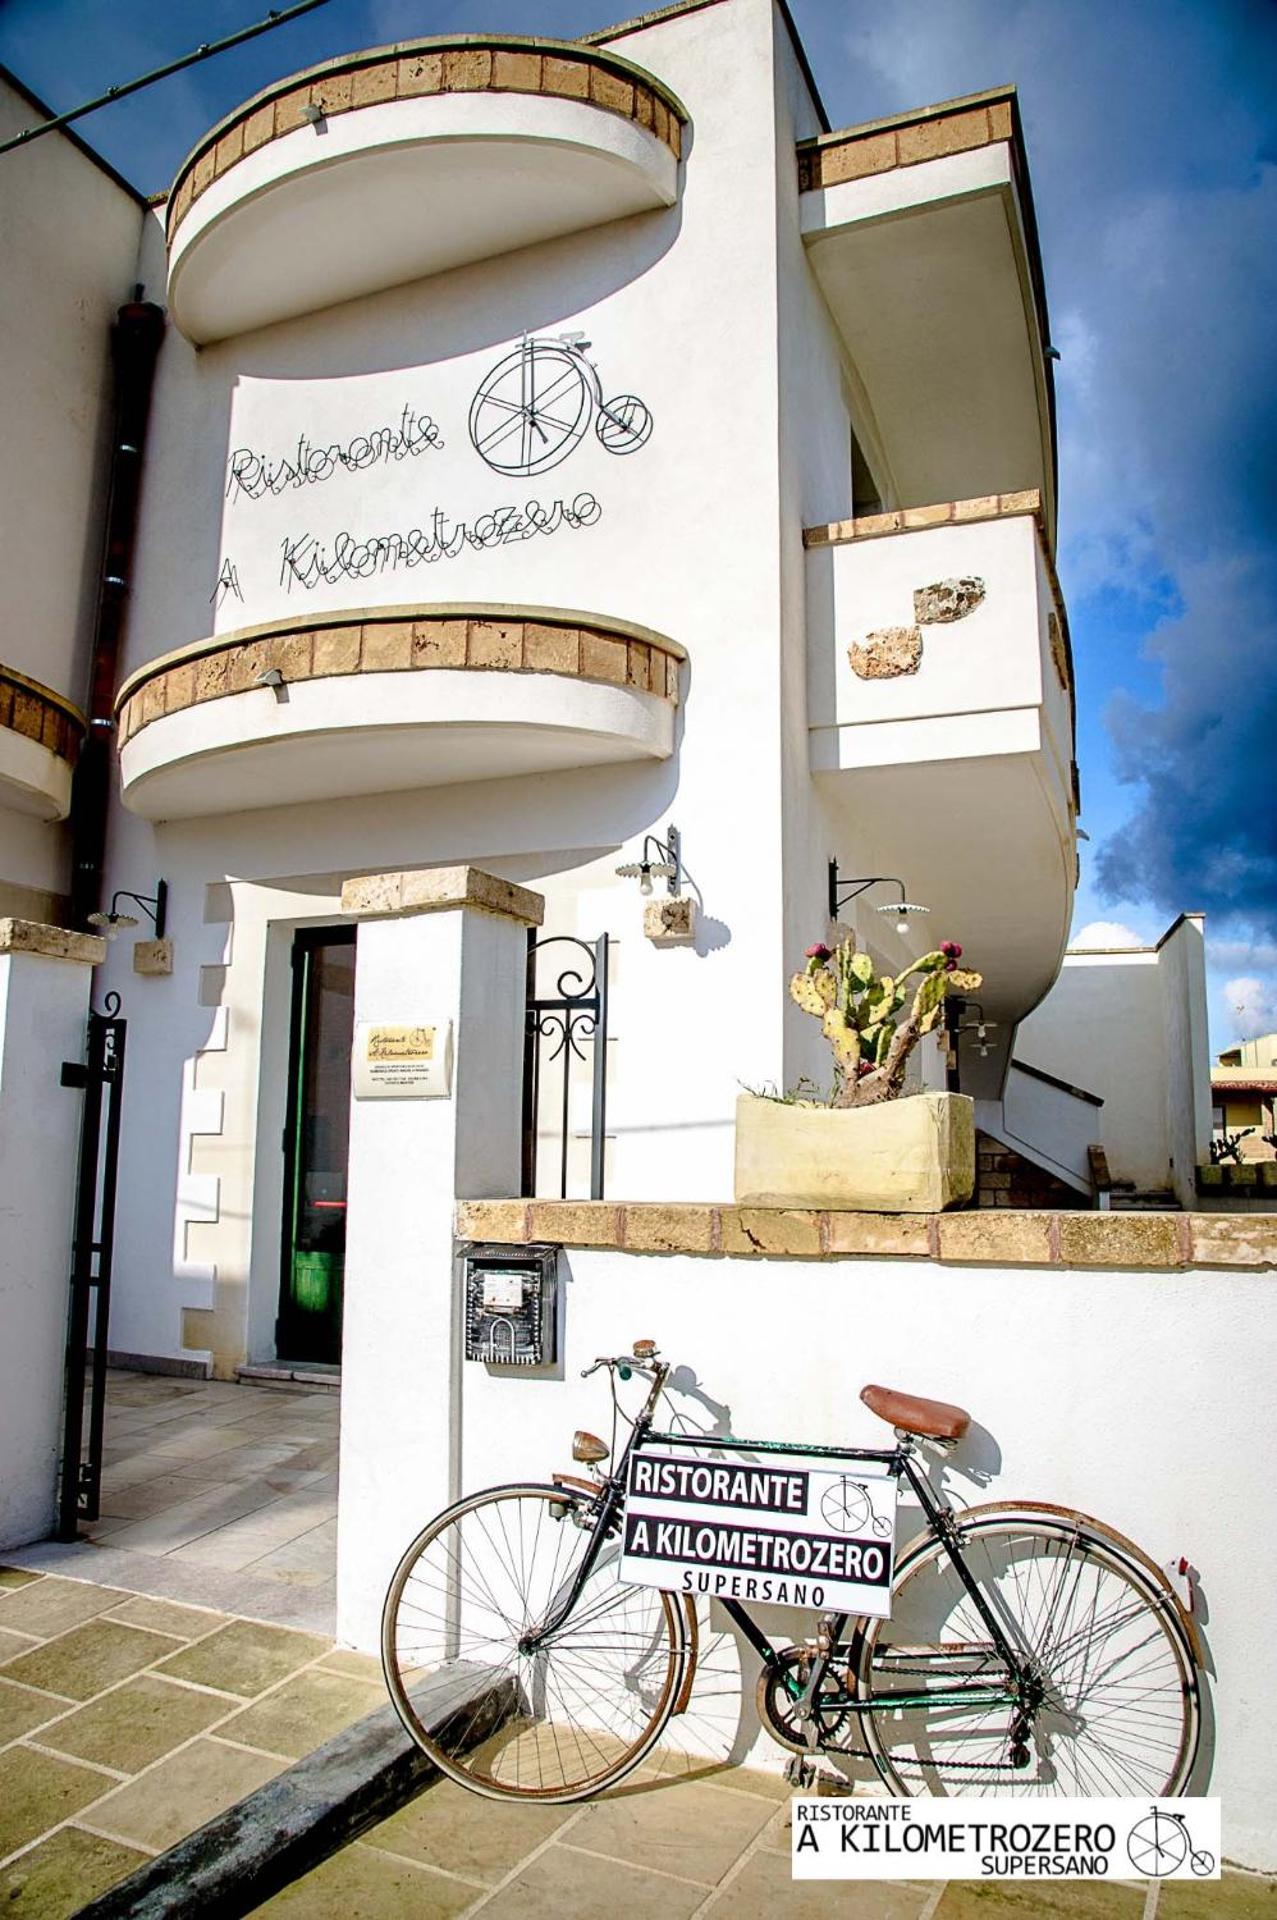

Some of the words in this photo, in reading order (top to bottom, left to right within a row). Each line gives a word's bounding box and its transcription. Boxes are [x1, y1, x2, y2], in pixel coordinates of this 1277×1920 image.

[227, 403, 444, 504] Ristorante
[210, 558, 244, 609] A
[280, 493, 601, 594] Kilometrozero
[635, 1462, 803, 1509] RISTORANTE
[631, 1521, 649, 1553] A
[656, 1524, 884, 1580] KILOMETROZERO
[682, 1570, 825, 1607] SUPERSANO
